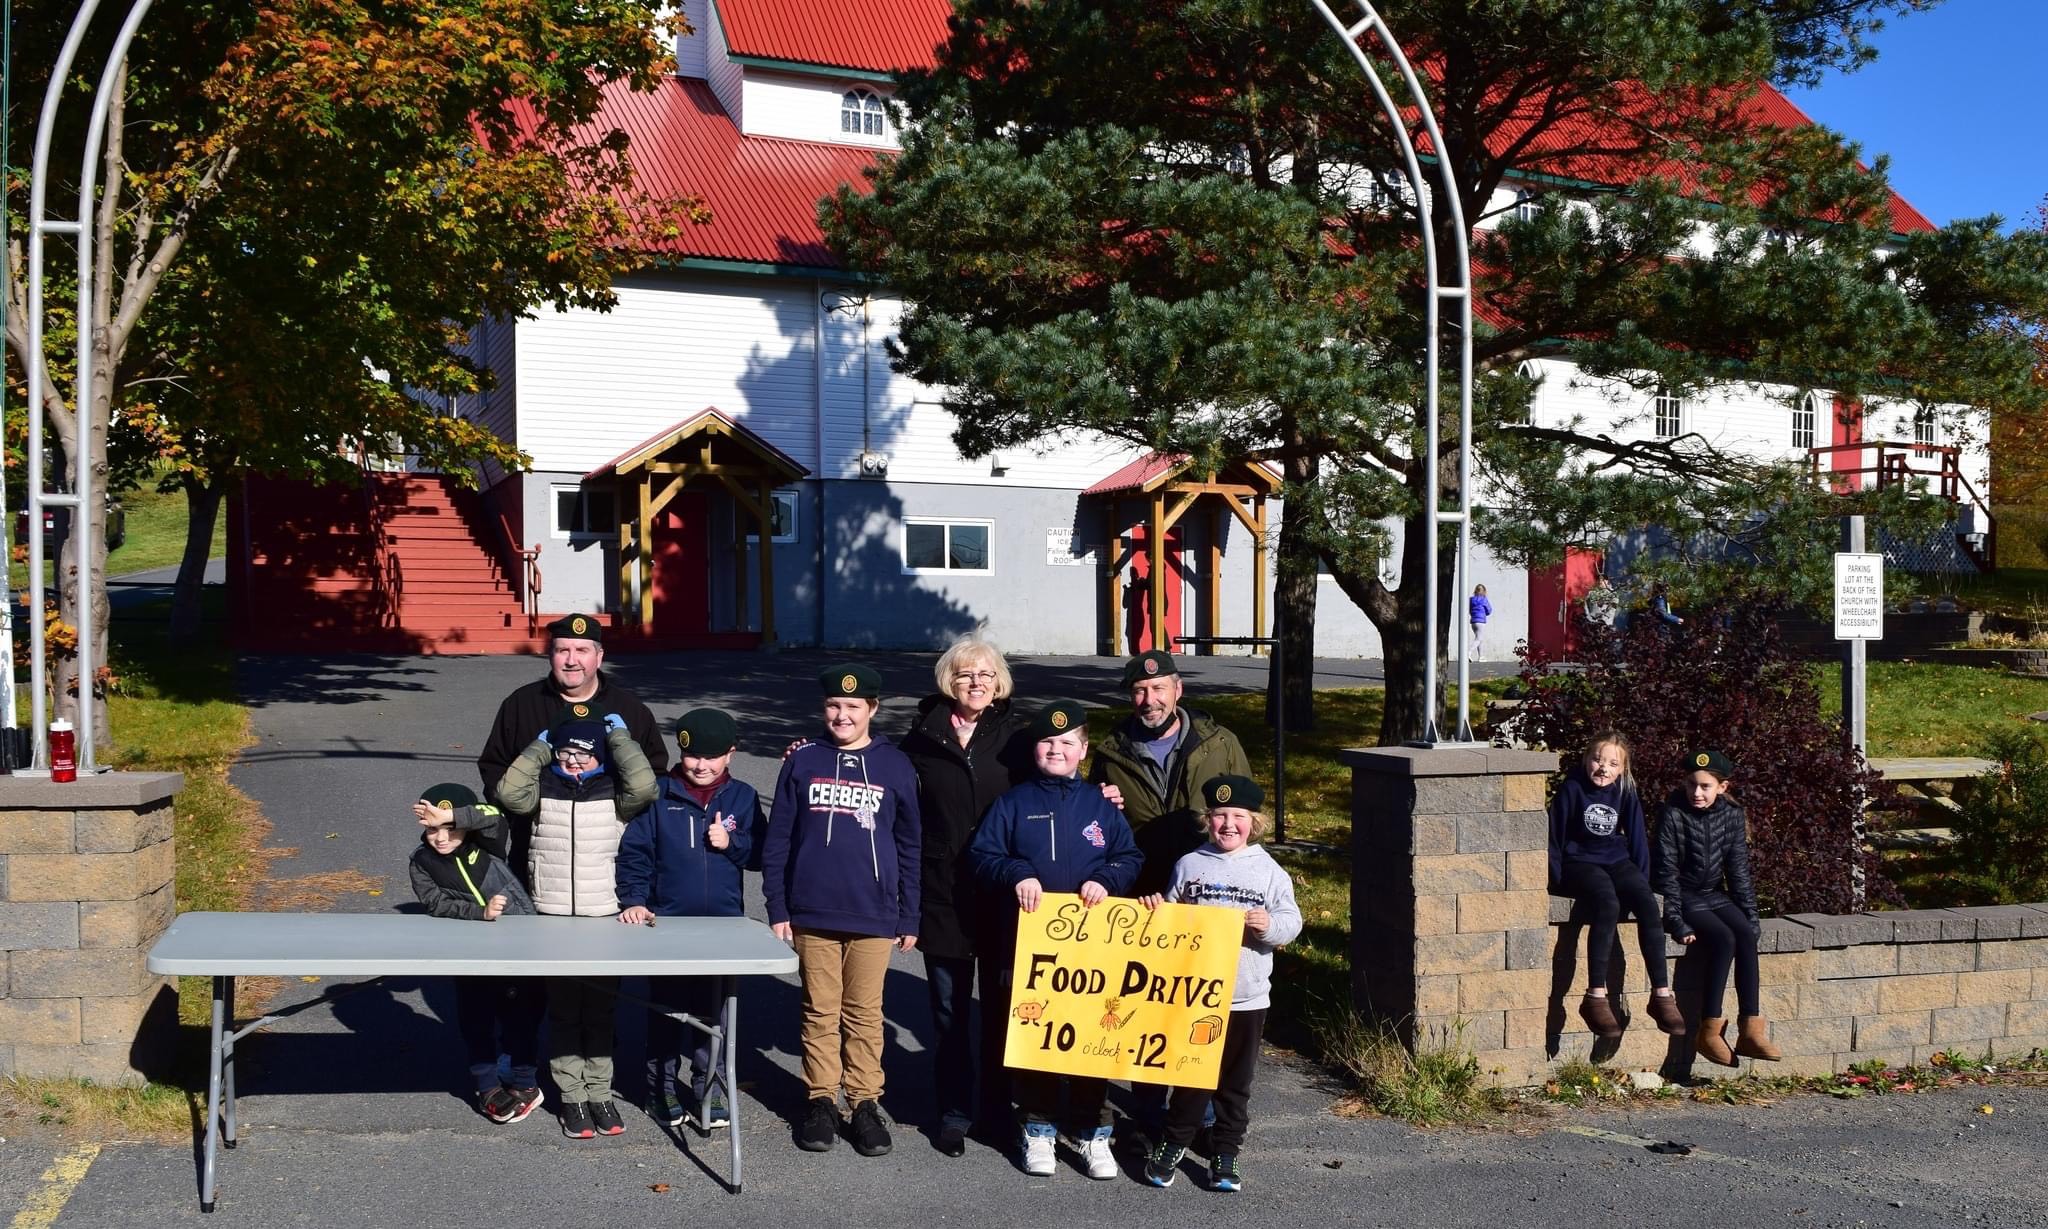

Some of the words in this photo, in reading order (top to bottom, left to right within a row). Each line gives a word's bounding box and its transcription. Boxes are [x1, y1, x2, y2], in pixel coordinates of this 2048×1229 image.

[1047, 529, 1080, 537] CAUTION
[1848, 564, 1871, 573] PARKING
[1845, 575, 1854, 583] LOT
[1864, 576, 1874, 584] THE
[1842, 586, 1856, 594] BACK
[1858, 586, 1864, 594] OF
[1841, 597, 1862, 605] CHURCH
[1864, 597, 1878, 605] WITH
[1842, 608, 1876, 616] WHEELCHAIR
[1840, 618, 1878, 627] ACCESSIBILITY
[809, 783, 884, 813] CEEBEES
[1188, 884, 1265, 902] Champion
[1045, 902, 1089, 942] St
[1104, 903, 1203, 951] Peter's
[1025, 952, 1106, 995] FOOD
[1118, 960, 1225, 1009] DRIVE
[1039, 1021, 1076, 1052] 10
[1082, 1036, 1122, 1063] o'clock
